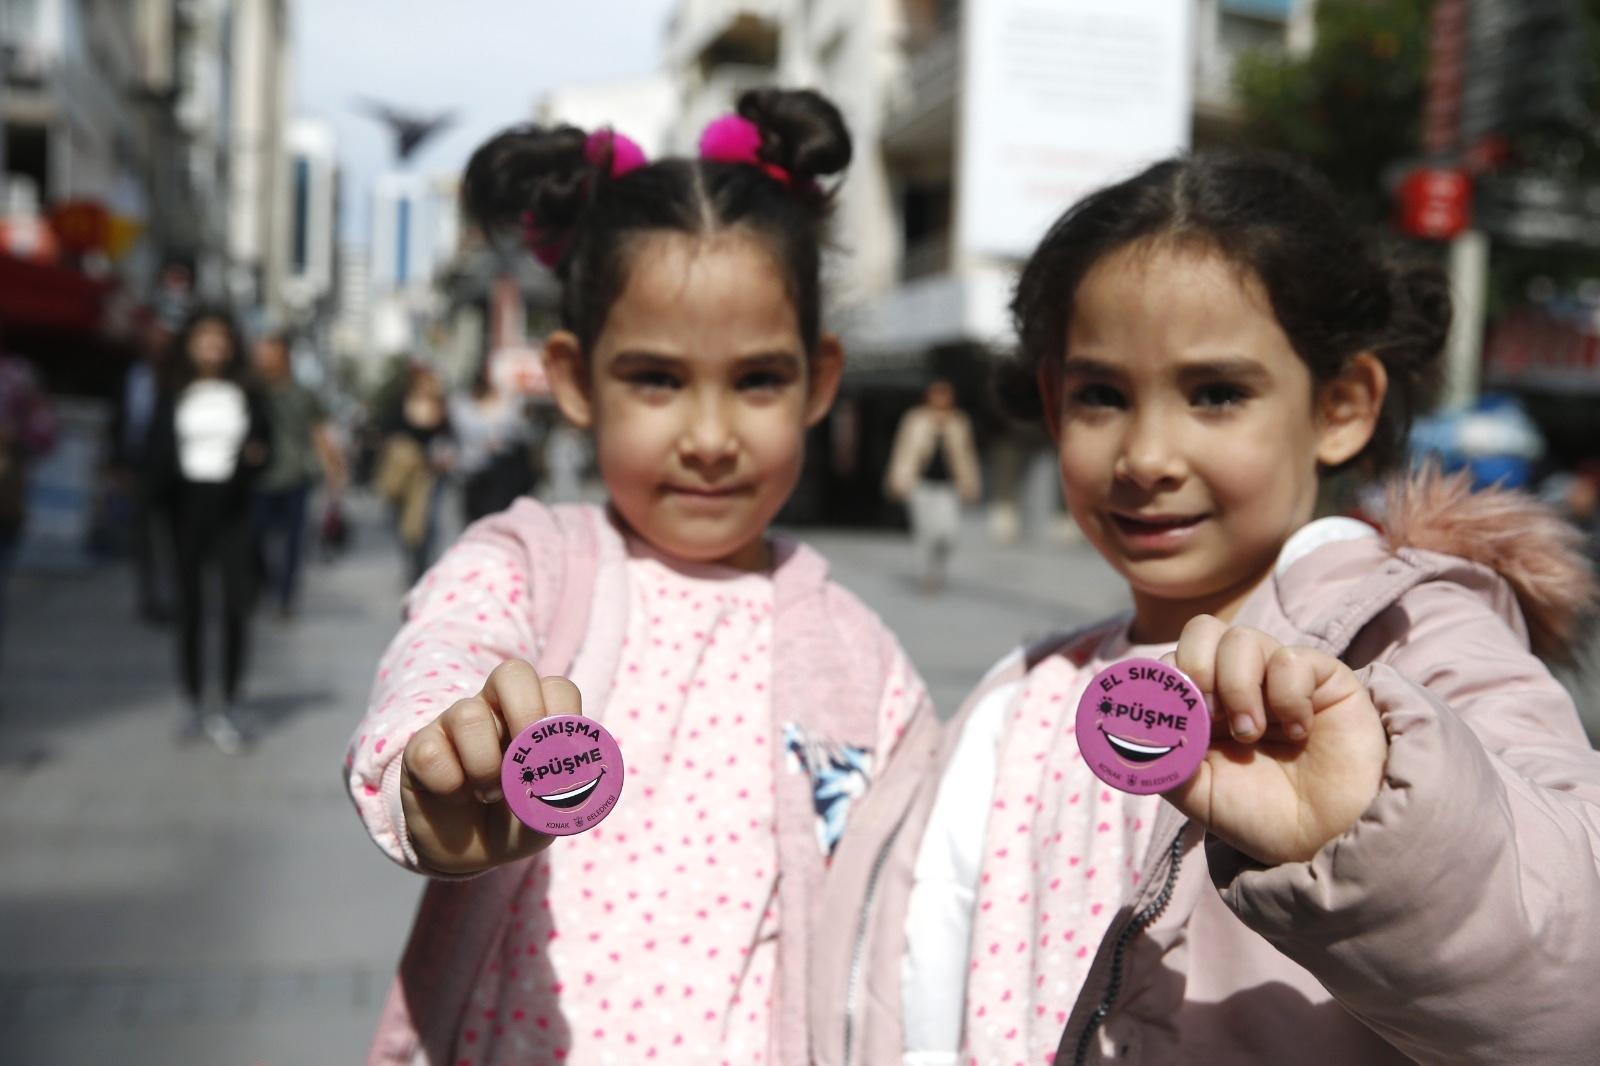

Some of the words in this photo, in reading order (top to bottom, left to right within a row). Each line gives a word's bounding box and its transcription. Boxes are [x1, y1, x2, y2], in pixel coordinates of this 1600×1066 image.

[1099, 674, 1123, 692] EL
[1128, 667, 1198, 711] SIKIŞMA
[513, 747, 532, 765] EL
[531, 721, 600, 743] SIKIŞMA
[546, 821, 570, 829] KONAK
